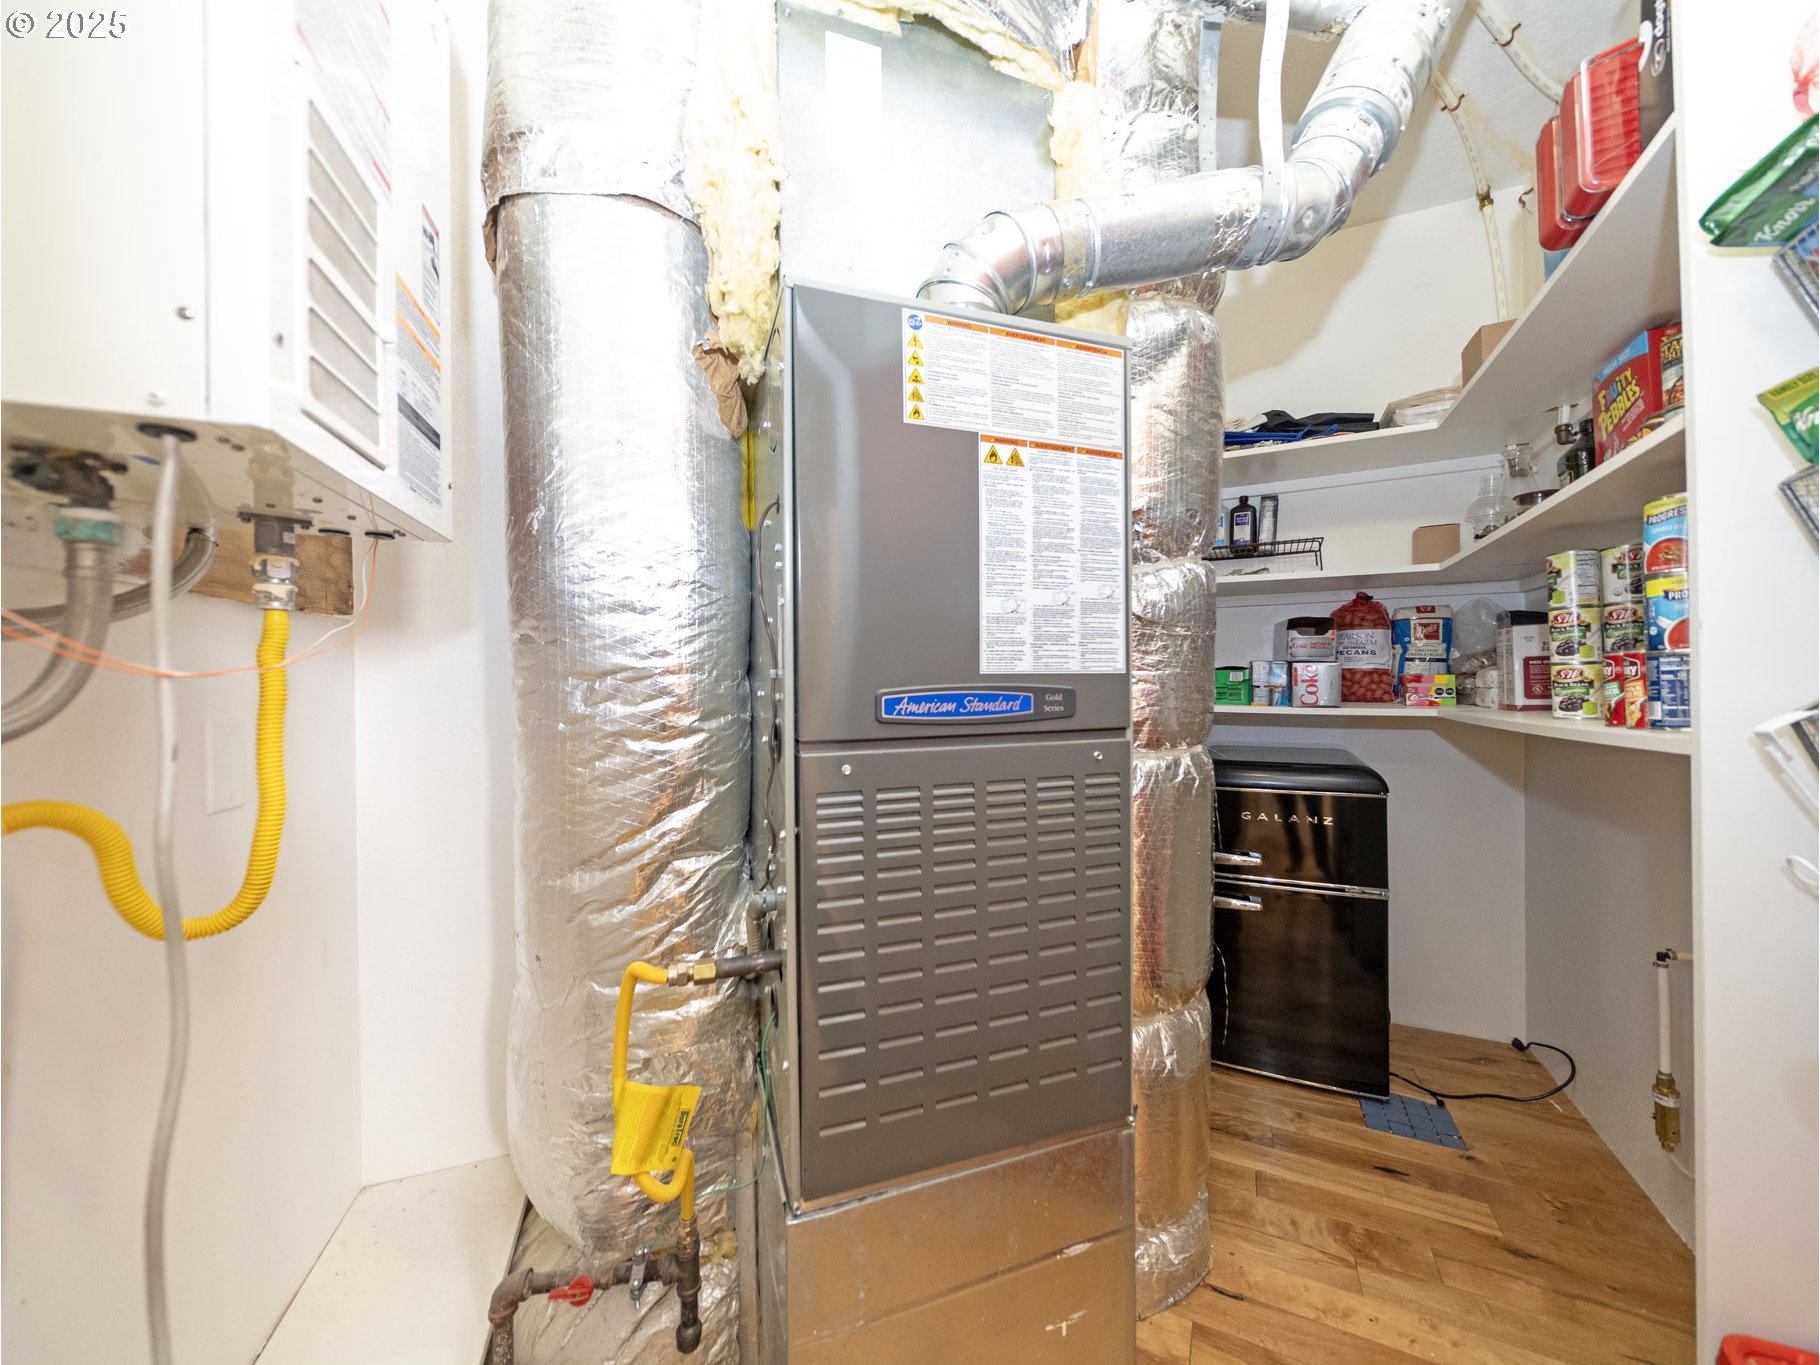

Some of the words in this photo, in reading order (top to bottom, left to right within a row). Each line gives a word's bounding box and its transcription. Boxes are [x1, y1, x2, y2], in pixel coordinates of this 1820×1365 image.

[1754, 197, 1816, 242] Knorr
[946, 320, 973, 330] WARNING
[1597, 379, 1641, 442] PEBBLES
[1299, 664, 1319, 706] Coke
[893, 696, 956, 716] American
[959, 694, 1024, 713] Standard
[1045, 693, 1063, 702] Gold
[1043, 704, 1064, 712] Series
[1240, 811, 1334, 826] GALANZ
